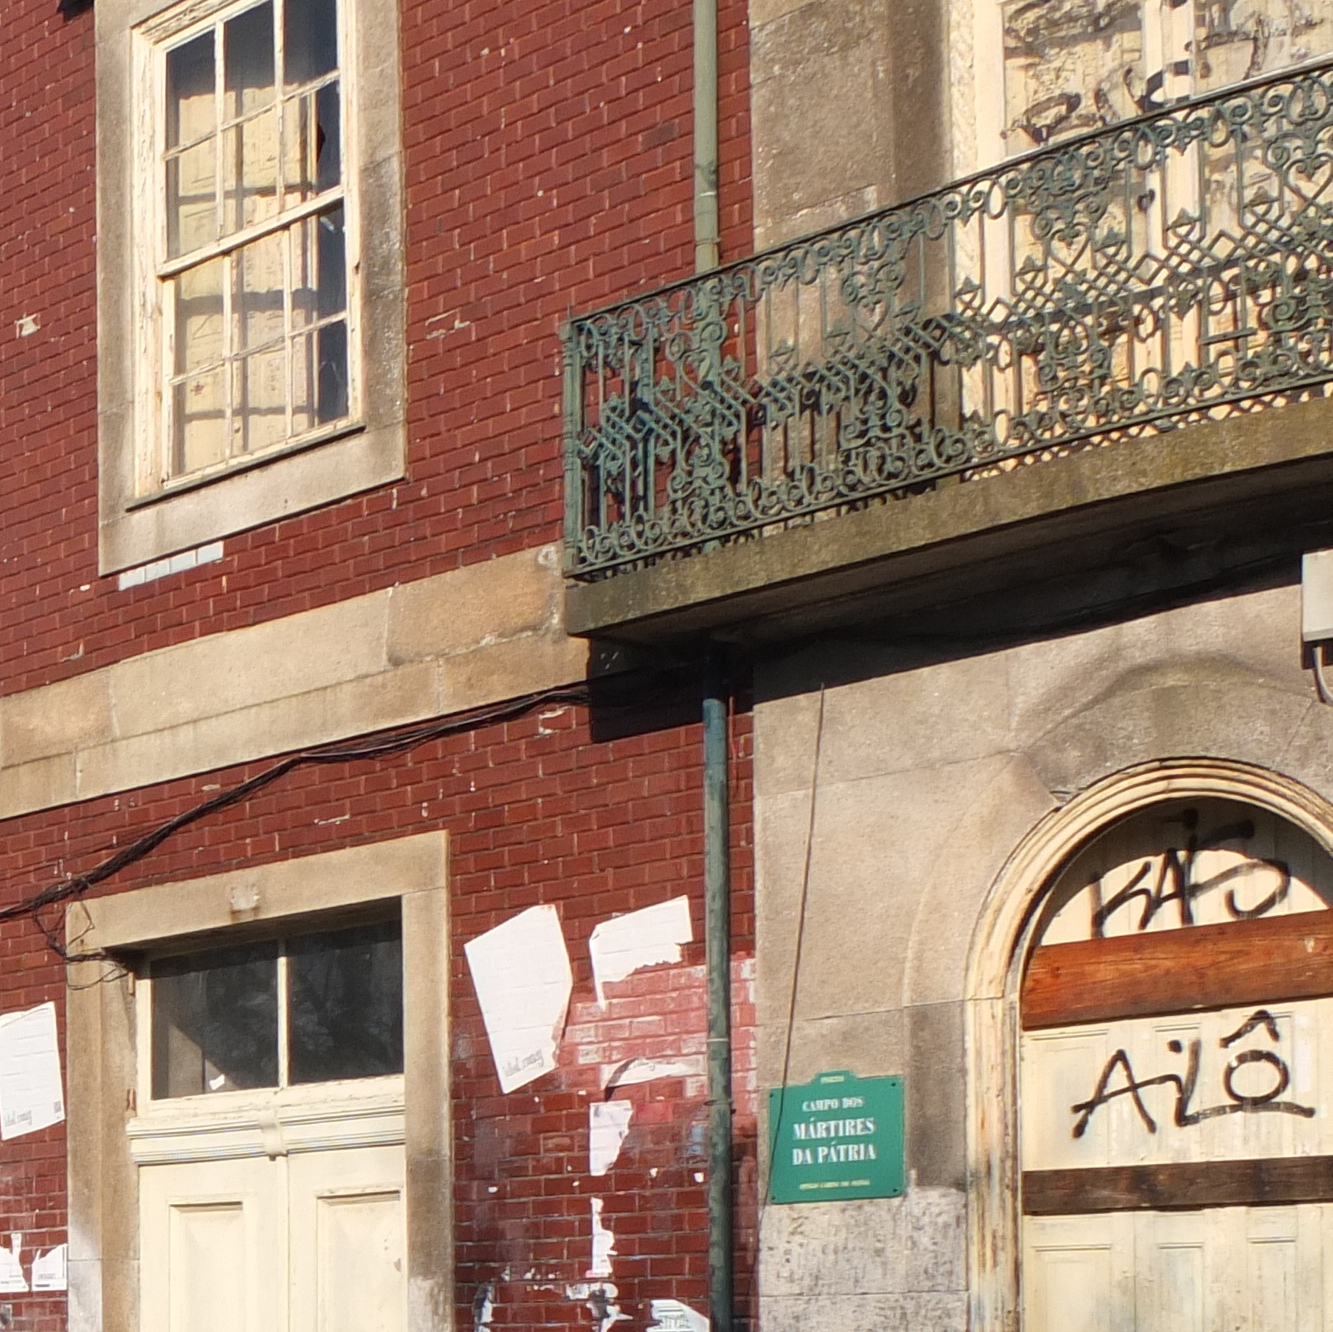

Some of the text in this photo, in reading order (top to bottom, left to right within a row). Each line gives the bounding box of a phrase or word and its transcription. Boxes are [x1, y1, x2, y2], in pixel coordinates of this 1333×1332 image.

[802, 1095, 864, 1112] CAMPO DOS
[793, 1117, 876, 1140] MÁRTIRES
[792, 1141, 876, 1165] DA PÁTRIA
